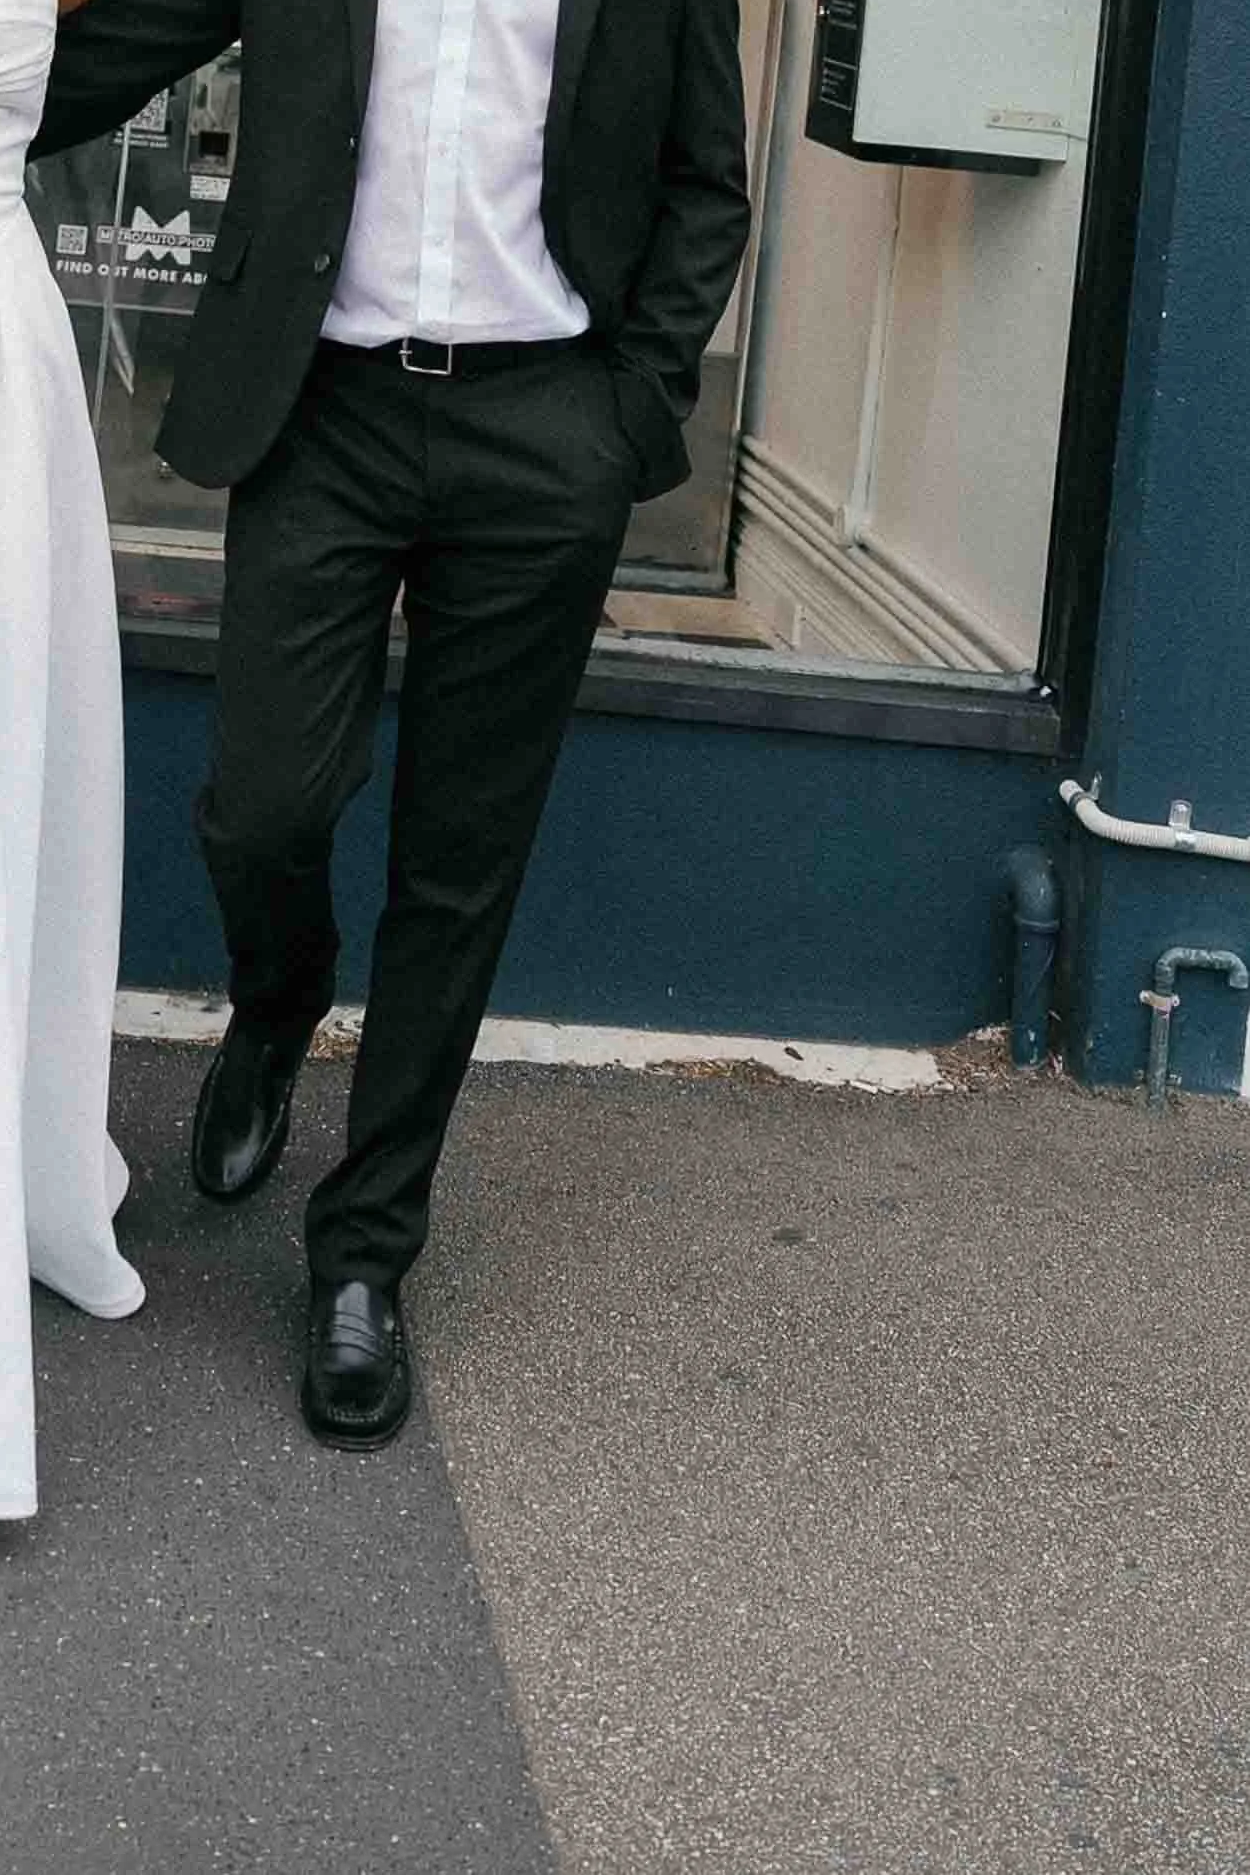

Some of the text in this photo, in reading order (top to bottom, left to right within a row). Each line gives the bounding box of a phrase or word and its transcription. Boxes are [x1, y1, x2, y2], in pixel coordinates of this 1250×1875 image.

[100, 228, 216, 248] MTRO AUTO PHOT
[56, 259, 93, 274] FIND
[133, 266, 178, 283] MORE
[181, 272, 208, 286] AB
